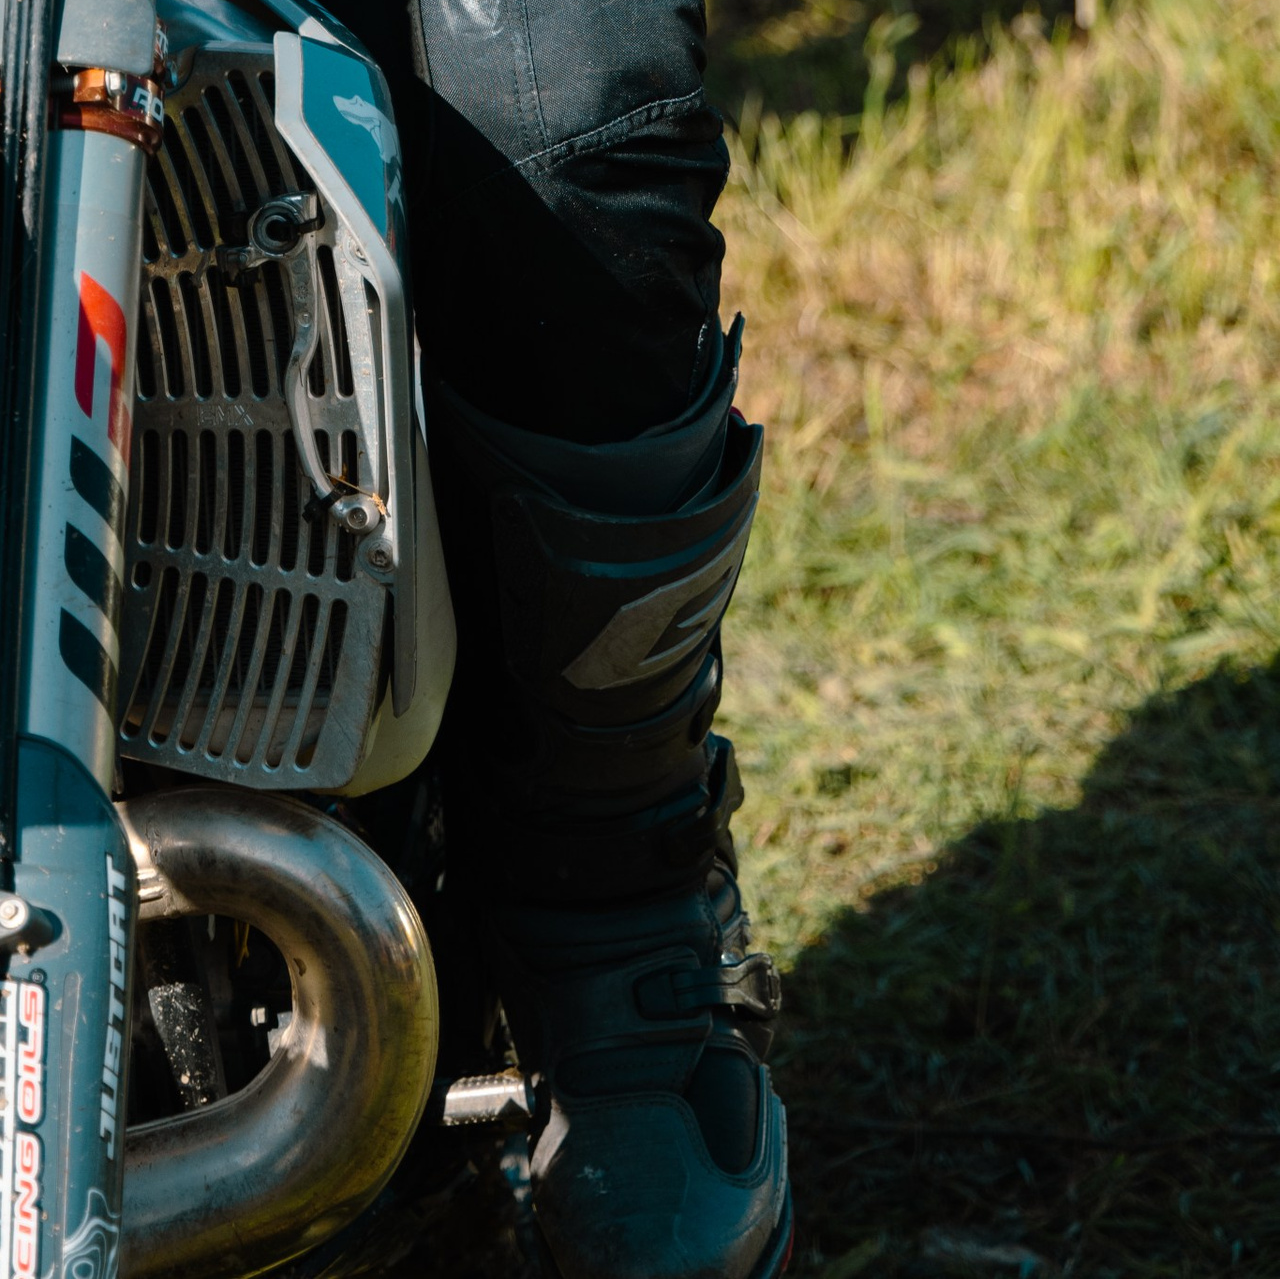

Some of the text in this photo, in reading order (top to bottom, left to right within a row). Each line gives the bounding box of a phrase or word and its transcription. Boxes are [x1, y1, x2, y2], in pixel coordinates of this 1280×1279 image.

[14, 987, 43, 1279] CING OILS
[99, 853, 126, 1161] JUSTCAT
